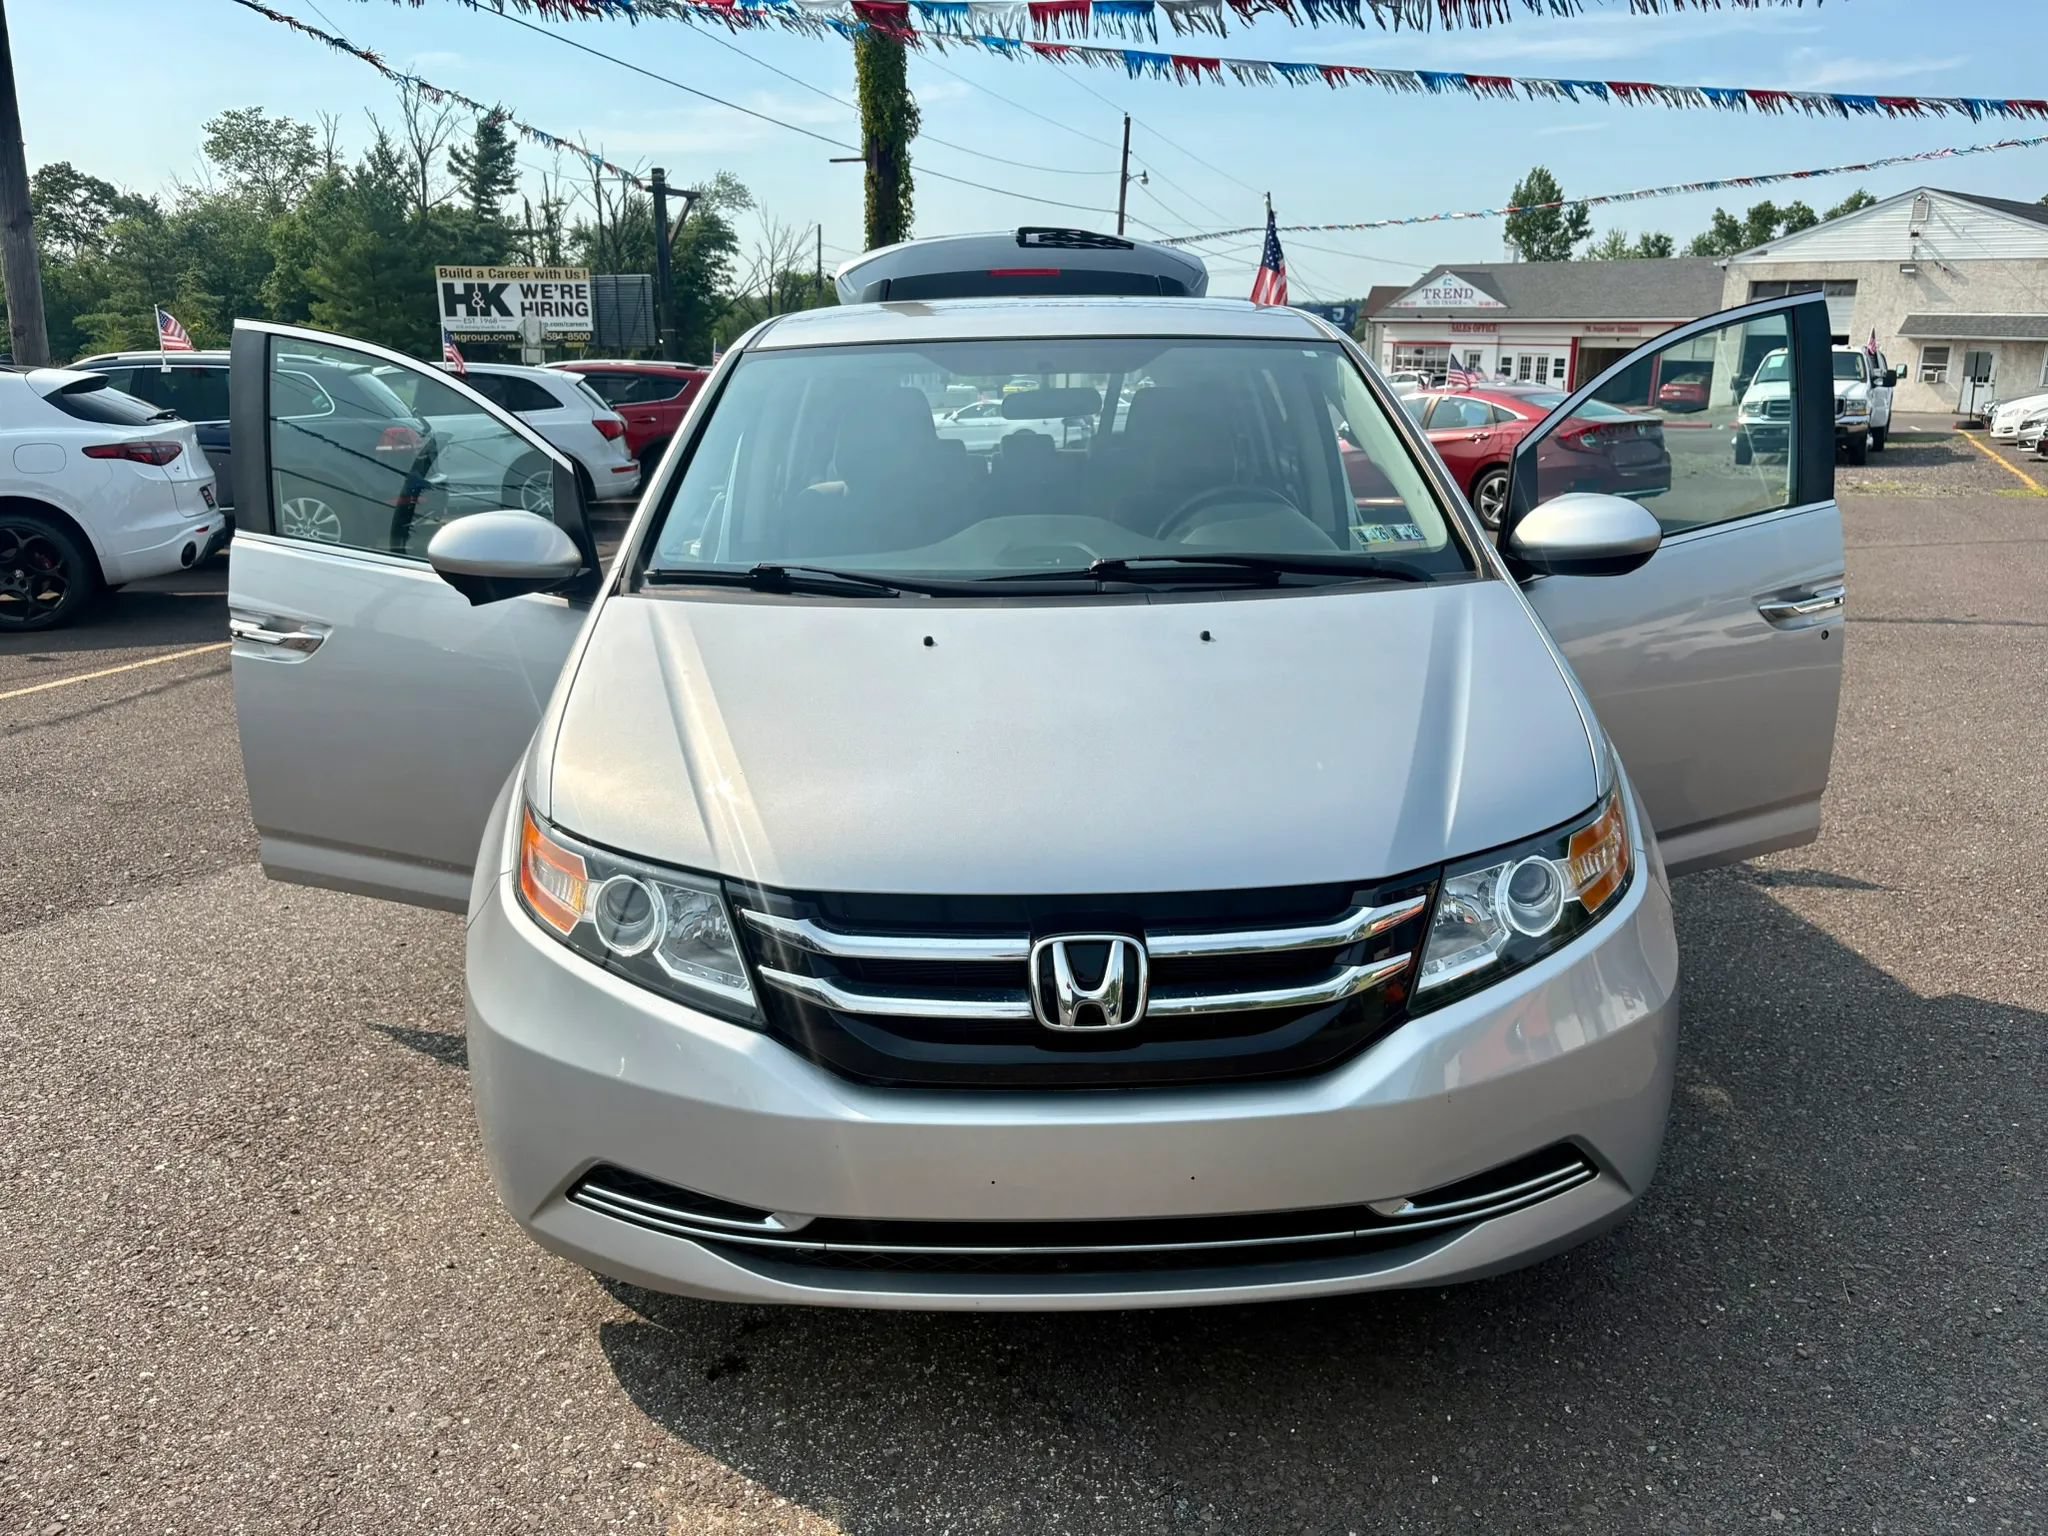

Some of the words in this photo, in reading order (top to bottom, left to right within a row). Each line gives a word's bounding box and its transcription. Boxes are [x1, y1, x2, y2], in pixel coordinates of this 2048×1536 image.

[439, 267, 473, 279] Build
[476, 270, 484, 279] a
[488, 268, 529, 279] Career
[533, 269, 561, 279] with
[520, 283, 588, 300] WE'RE
[1421, 288, 1474, 299] TREND
[442, 282, 515, 317] H&K
[520, 301, 589, 317] HIRING
[1451, 323, 1471, 333] SALES
[1472, 323, 1497, 333] OFFICE
[546, 332, 591, 341] 584-8500
